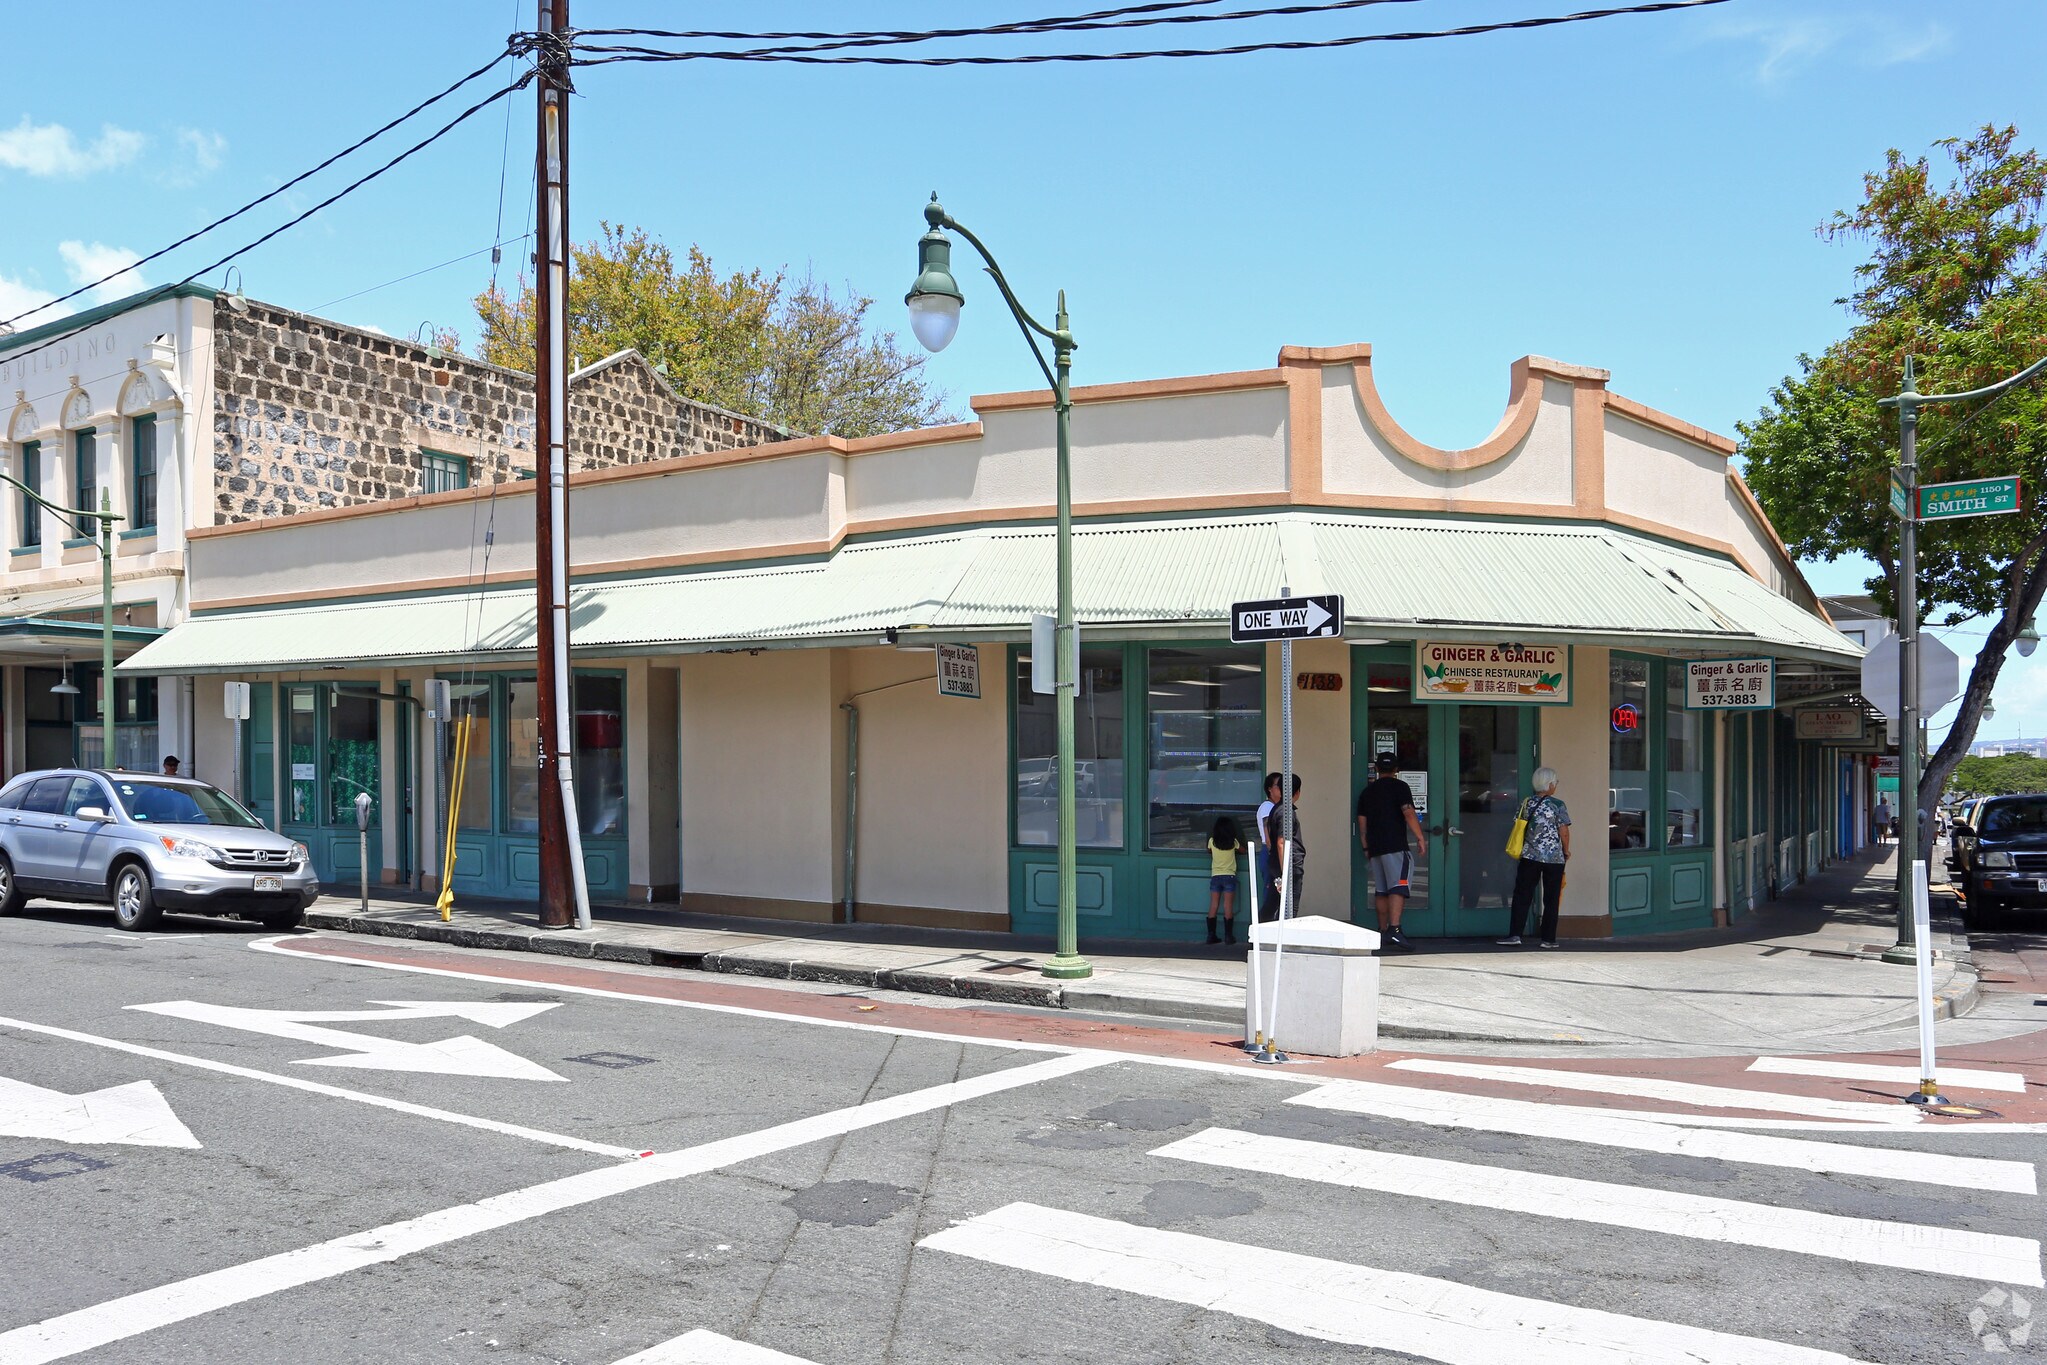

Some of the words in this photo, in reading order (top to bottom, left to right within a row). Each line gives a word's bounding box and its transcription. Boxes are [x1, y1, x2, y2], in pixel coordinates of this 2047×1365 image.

[1980, 485, 2002, 494] 1150
[1927, 497, 1988, 514] SMITH
[1994, 495, 2009, 503] ST
[1243, 612, 1272, 629] ONE
[1279, 609, 1309, 626] WAY
[940, 644, 956, 661] Ginger
[956, 648, 961, 660] &
[961, 649, 976, 662] Garlic
[1432, 647, 1486, 662] GINGER
[1490, 649, 1500, 662] &
[1504, 649, 1556, 664] GARLIC
[1443, 667, 1482, 677] CHINESE
[1485, 668, 1544, 679] RESTAURANT
[1690, 664, 1724, 677] Ginger
[1726, 663, 1734, 674] &
[1737, 662, 1769, 674] Garlic
[947, 680, 974, 693] 537-3883
[1702, 694, 1757, 705] 537-3883
[1612, 708, 1637, 728] OPEN
[1815, 713, 1842, 721] LAO
